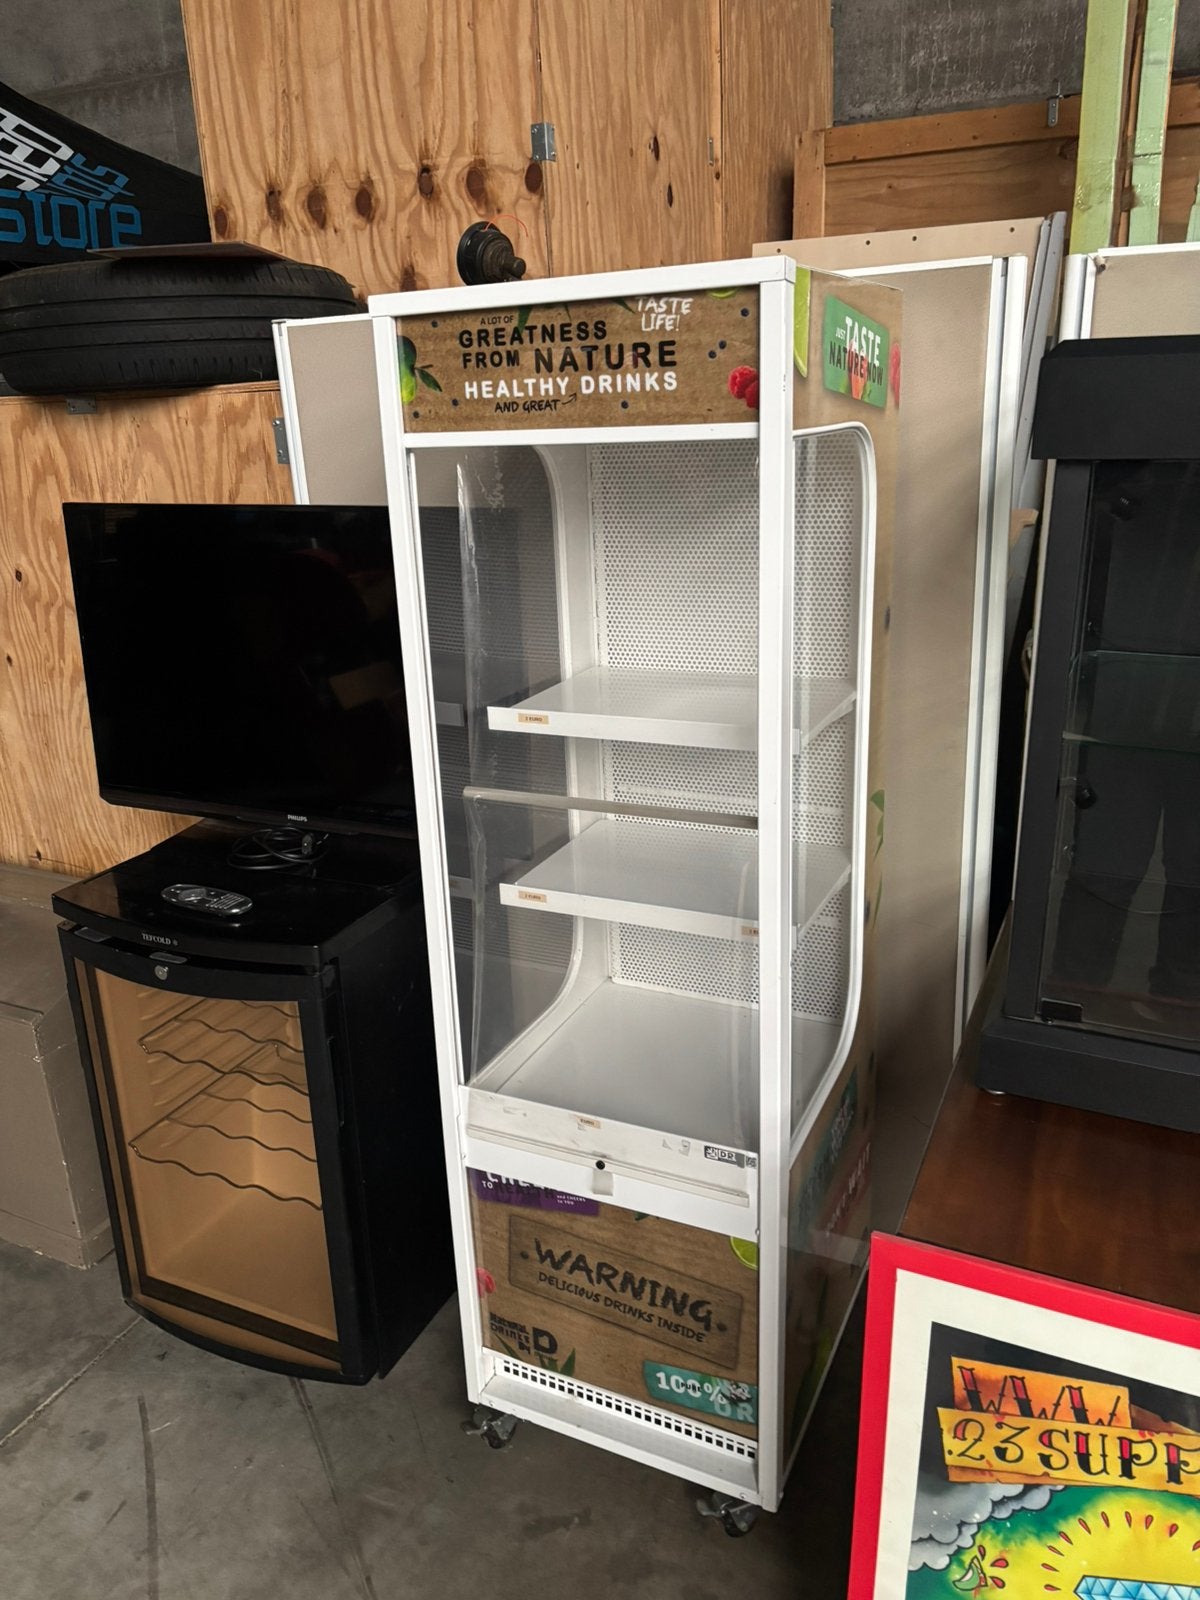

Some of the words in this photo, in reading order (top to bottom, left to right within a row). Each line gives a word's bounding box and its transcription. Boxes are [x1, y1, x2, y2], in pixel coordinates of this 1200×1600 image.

[487, 316, 502, 325] LOT
[503, 315, 514, 323] OF
[636, 297, 693, 315] TASTE
[459, 320, 606, 349] GREATNESS
[641, 313, 680, 332] LIFE!
[462, 349, 520, 370] FROM
[534, 340, 677, 374] NATURE
[845, 316, 881, 368] TASTE
[829, 341, 864, 378] NATURE
[866, 361, 884, 386] NOW
[464, 376, 570, 400] HEALTHY
[580, 371, 678, 395] DRINKS
[494, 401, 519, 413] AND
[522, 398, 560, 413] GREAT
[534, 1237, 713, 1332] WARNING
[538, 1271, 602, 1304] DELICIOUS
[603, 1295, 655, 1324] DRINKS
[656, 1315, 707, 1343] INSIDE
[656, 1371, 729, 1405] 100%
